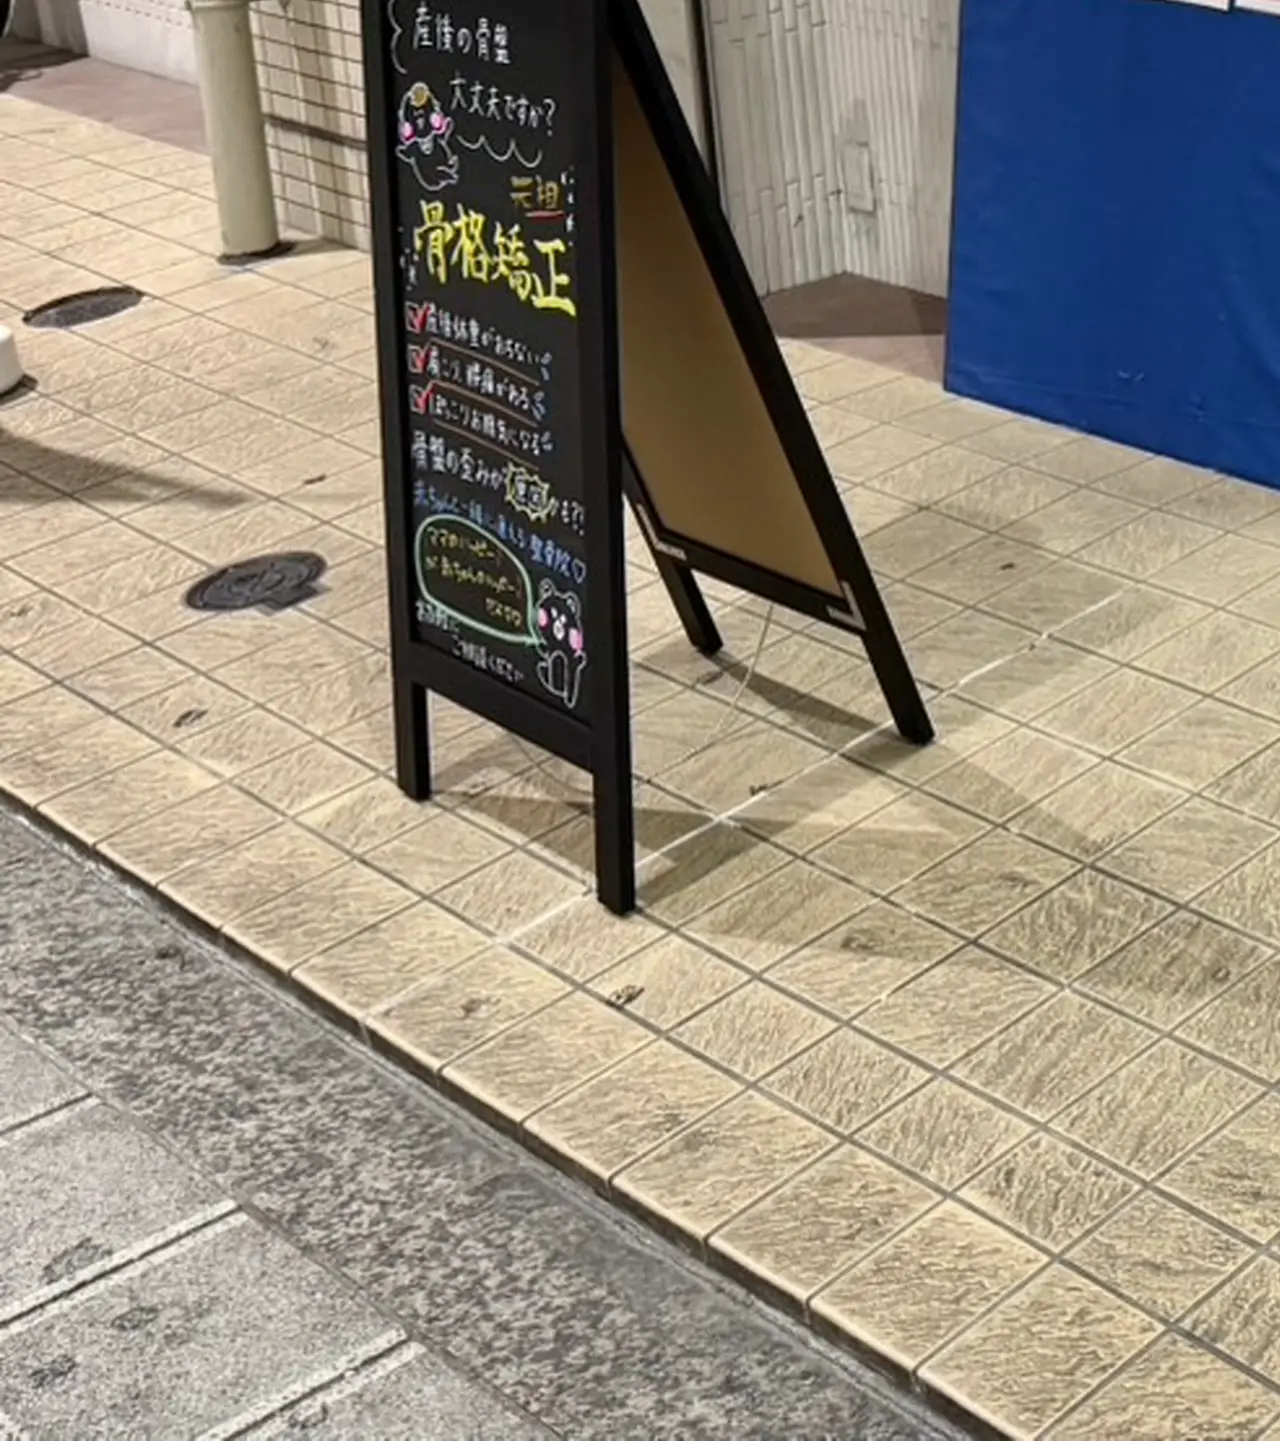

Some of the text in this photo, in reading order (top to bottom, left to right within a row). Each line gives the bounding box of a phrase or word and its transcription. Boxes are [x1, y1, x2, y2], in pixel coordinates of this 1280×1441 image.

[412, 1, 511, 65] 産後の骨盤
[510, 174, 560, 210] 元祖
[413, 198, 578, 317] 骨格矯正
